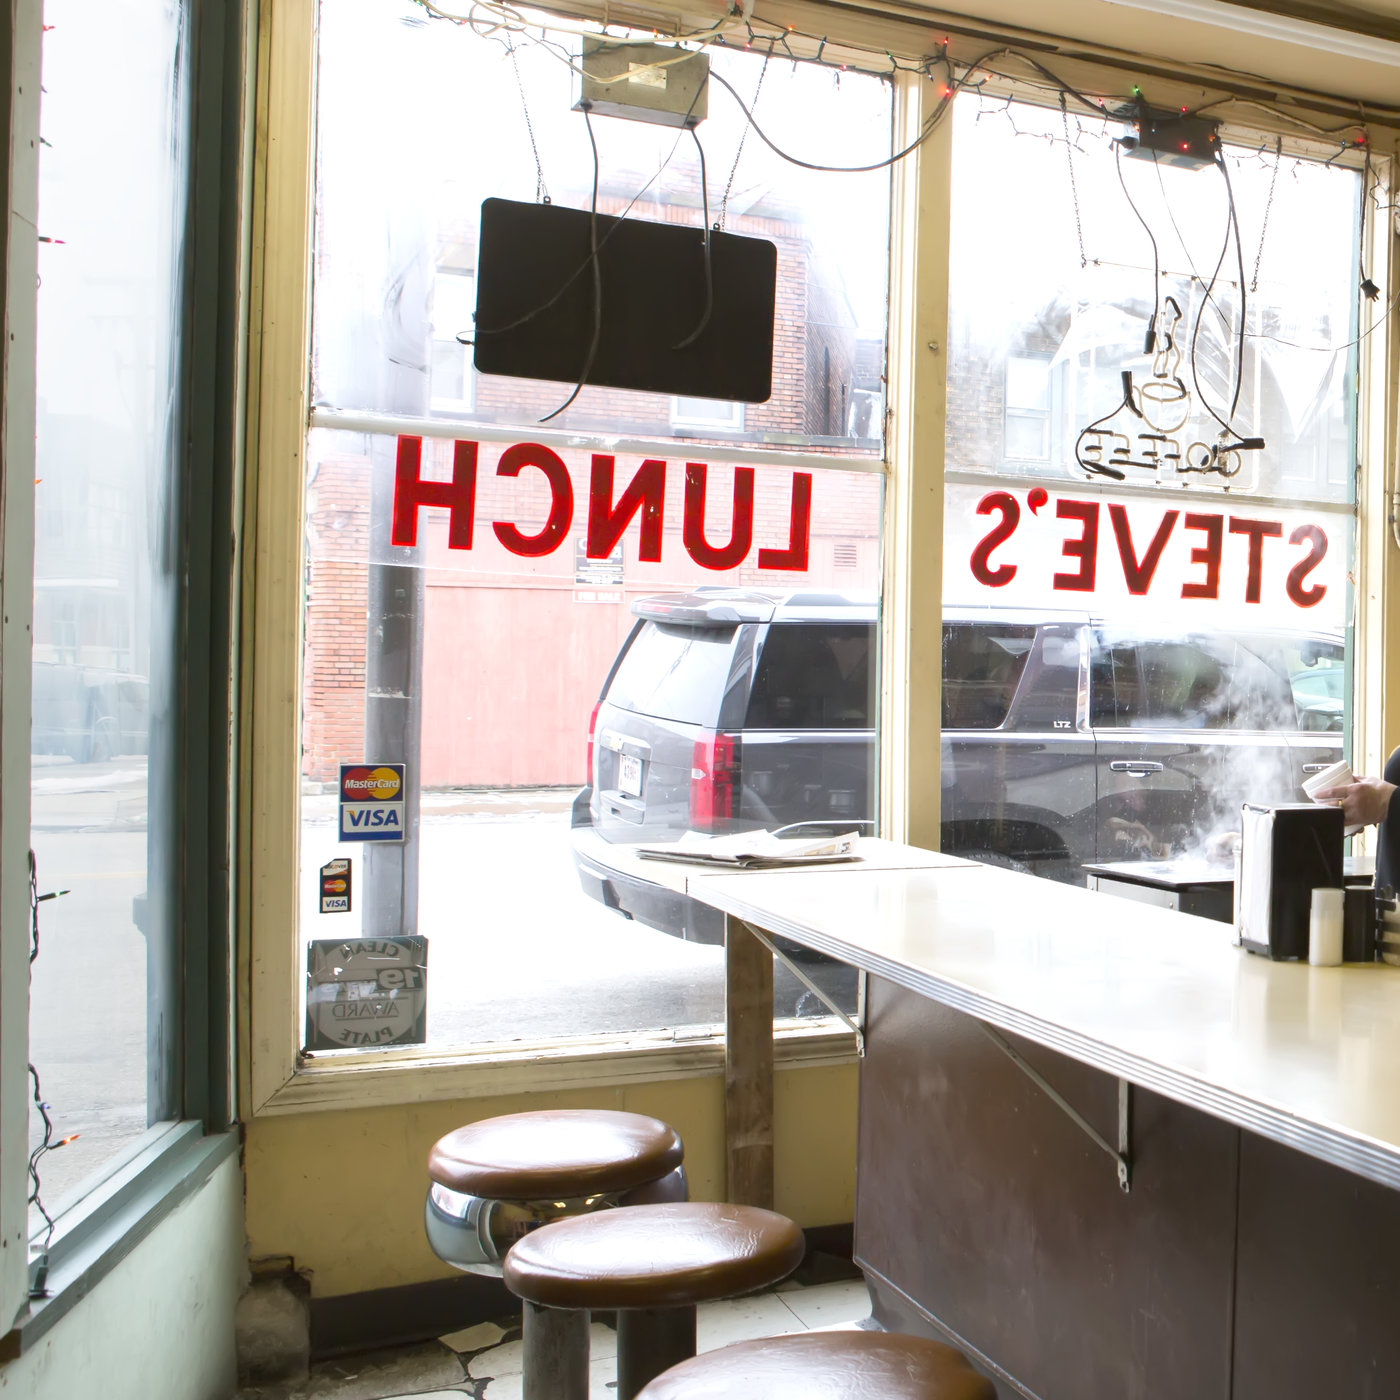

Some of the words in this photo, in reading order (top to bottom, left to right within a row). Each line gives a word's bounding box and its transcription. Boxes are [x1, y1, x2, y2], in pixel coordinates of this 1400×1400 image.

[1053, 720, 1071, 728] LTZ
[344, 778, 400, 790] MasterCard
[346, 809, 399, 827] VISA
[325, 900, 347, 908] VISA
